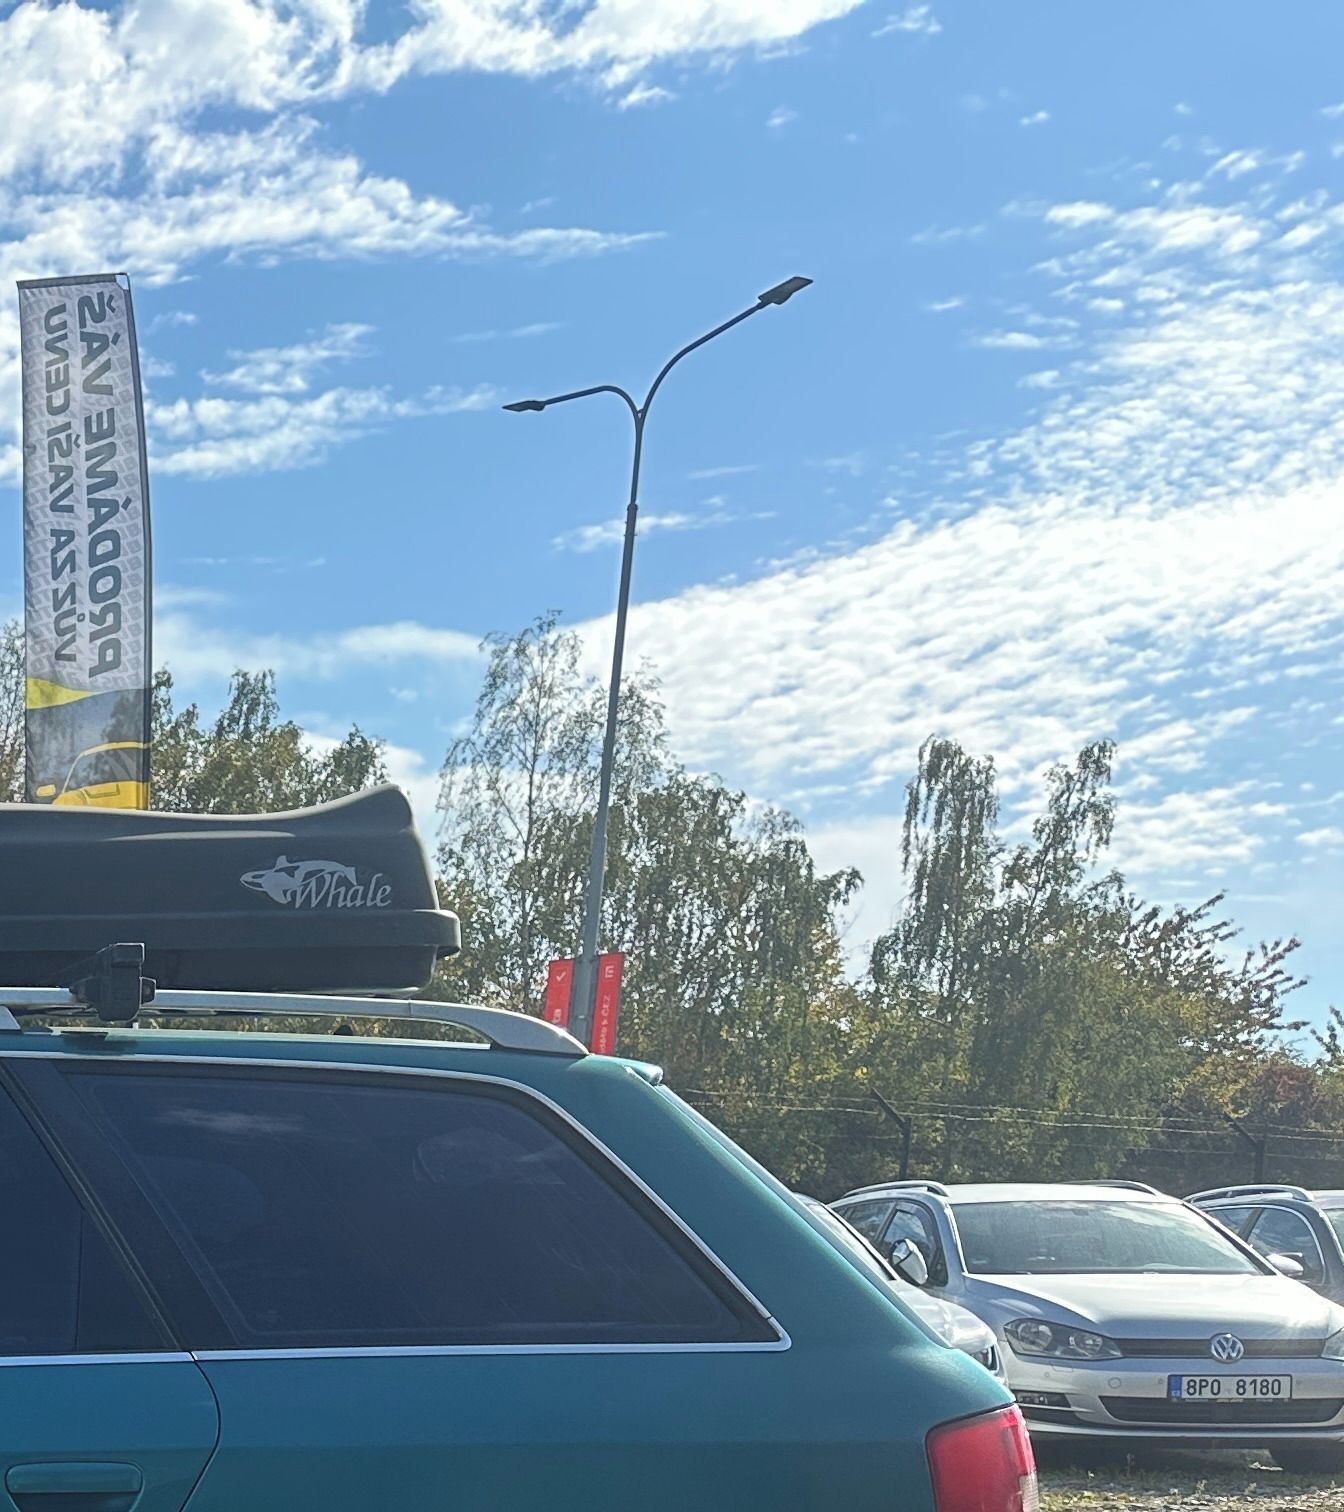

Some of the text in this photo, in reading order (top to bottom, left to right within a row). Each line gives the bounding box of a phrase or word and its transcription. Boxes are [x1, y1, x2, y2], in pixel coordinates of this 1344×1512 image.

[291, 871, 392, 909] Whale
[1186, 1378, 1221, 1396] 8P0
[1236, 1378, 1281, 1396] 8180
